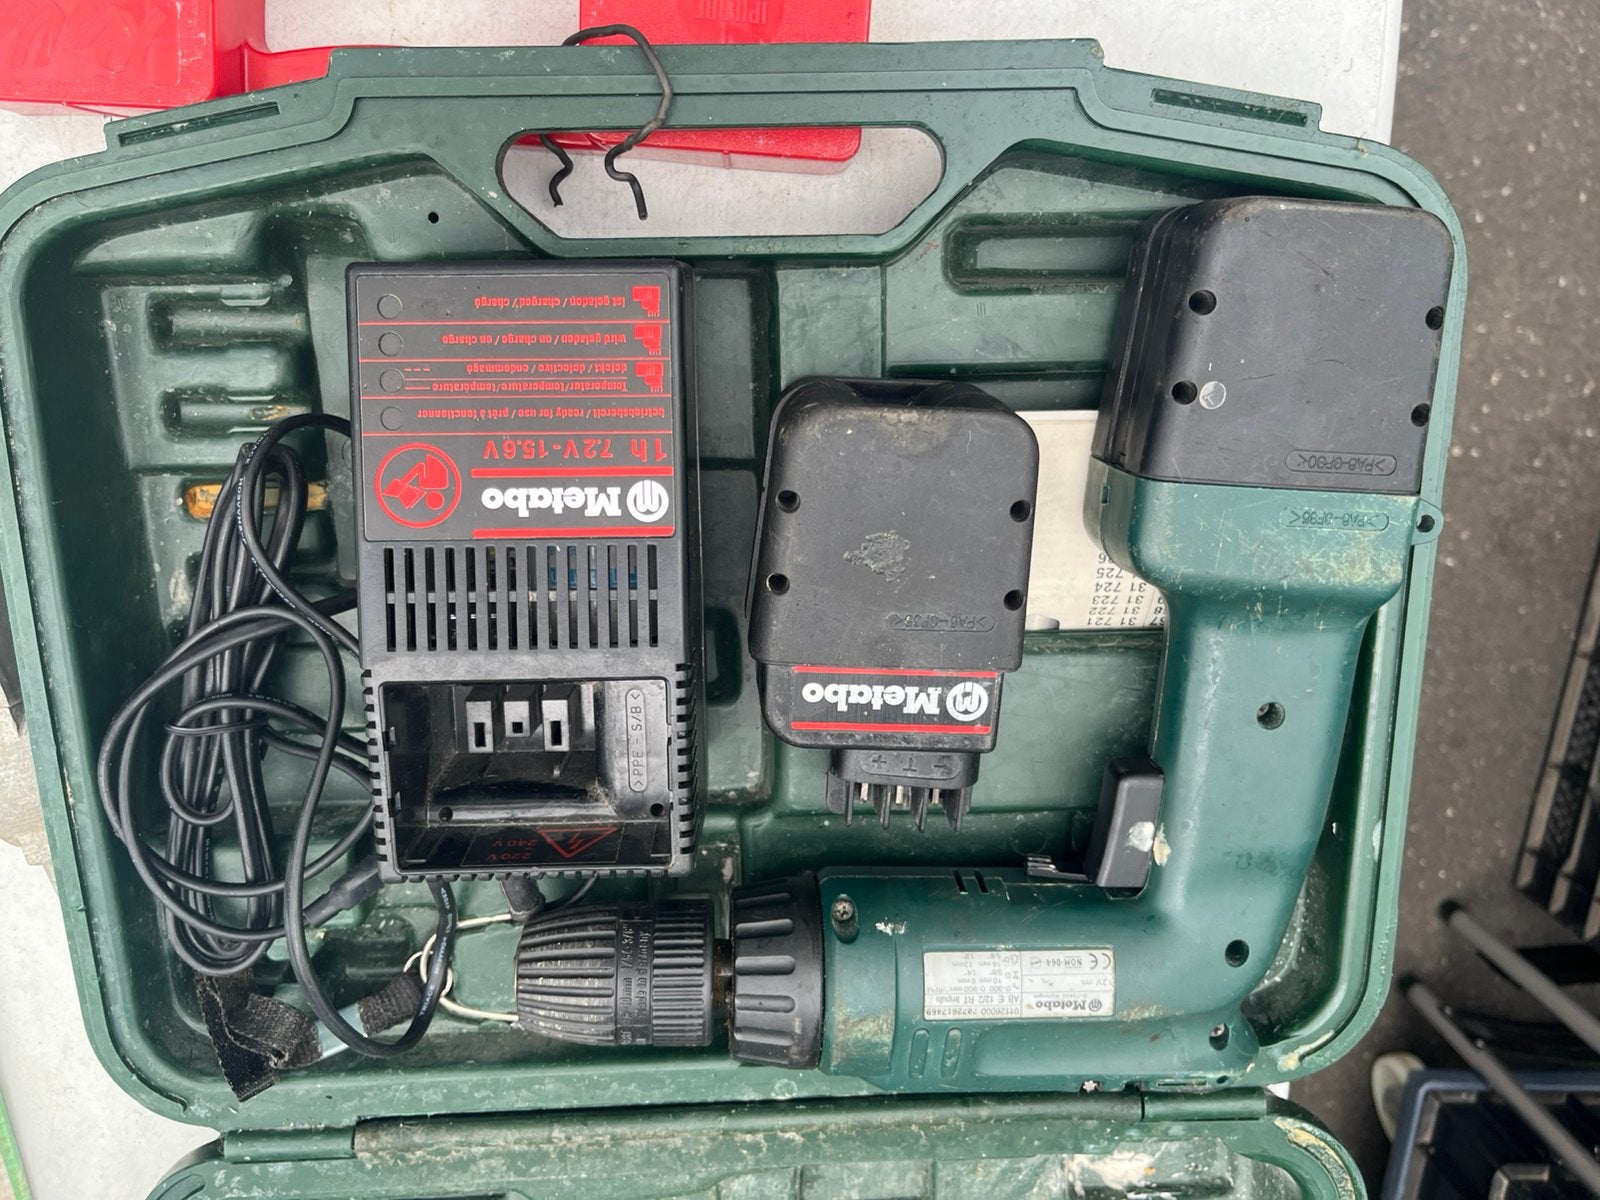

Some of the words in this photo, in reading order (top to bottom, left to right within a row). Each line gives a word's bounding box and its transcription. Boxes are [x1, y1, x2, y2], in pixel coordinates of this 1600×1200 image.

[474, 296, 509, 309] chargé
[519, 296, 560, 308] charged
[569, 295, 610, 308] geladen
[613, 297, 625, 307] ist
[442, 334, 477, 346] charge
[479, 335, 491, 344] en
[501, 333, 536, 345] charge
[539, 335, 553, 343] on
[561, 332, 600, 345] geladen
[604, 334, 626, 345] wird
[467, 362, 529, 374] endommagé
[538, 363, 585, 374] defective
[595, 363, 627, 374] defekt
[416, 409, 478, 420] fonctionner
[480, 409, 485, 420] à
[488, 407, 509, 419] prêt
[518, 409, 536, 417] use
[539, 408, 553, 419] for
[556, 407, 583, 419] ready
[593, 407, 665, 419] betriebsbereit
[481, 487, 621, 518] Metabo
[1096, 568, 1123, 578] 725
[1095, 582, 1121, 592] 724
[1130, 583, 1146, 592] 31
[1092, 596, 1118, 604] 723
[1127, 596, 1144, 604] 31
[1089, 607, 1115, 615] 722
[1087, 617, 1111, 625] 721
[1120, 617, 1136, 626] 31
[802, 682, 941, 715] Metabo
[498, 852, 531, 860] 220
[1035, 1000, 1086, 1011] Metabo
